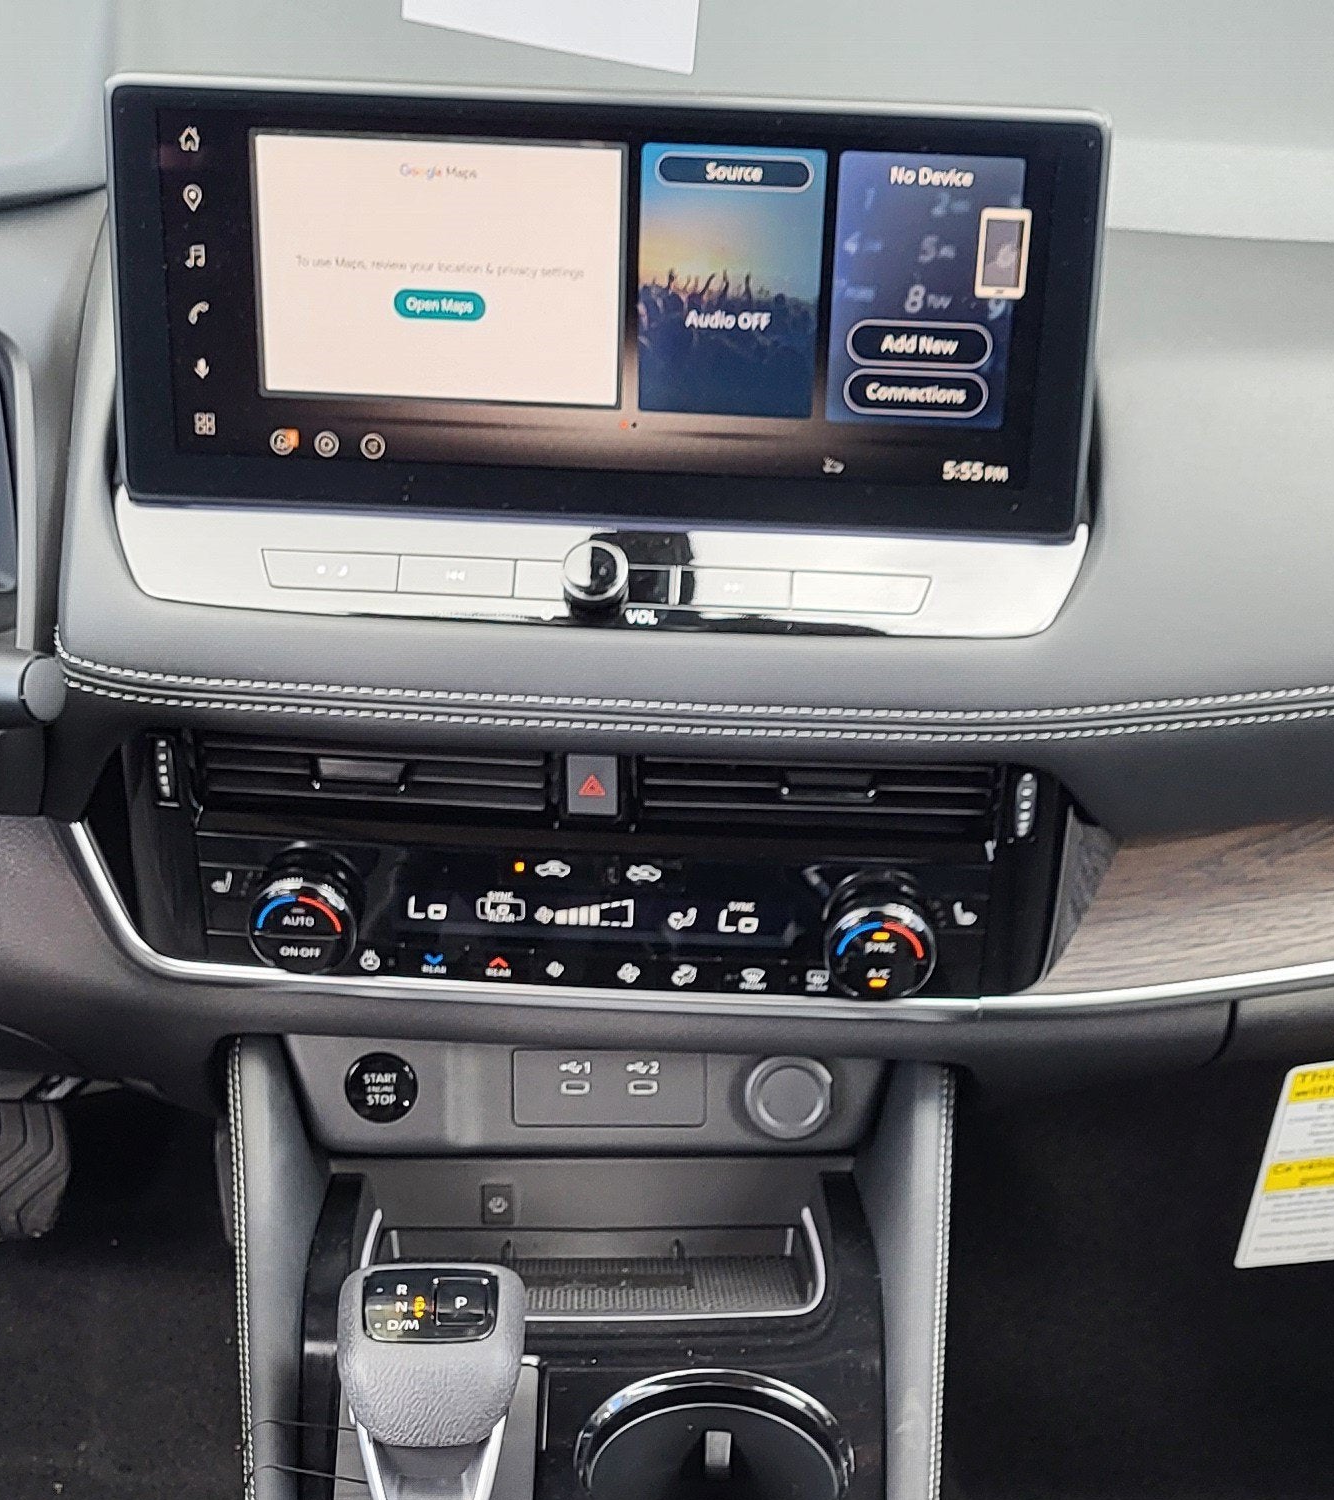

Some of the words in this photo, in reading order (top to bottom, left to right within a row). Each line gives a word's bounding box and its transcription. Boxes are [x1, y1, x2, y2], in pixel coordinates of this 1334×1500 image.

[400, 163, 441, 179] Google
[445, 165, 478, 179] Maps
[704, 162, 764, 183] Source
[890, 165, 916, 185] No
[918, 166, 975, 187] Device
[296, 255, 310, 267] To
[437, 261, 483, 273] location
[496, 265, 537, 279] privacy
[540, 266, 585, 281] settings
[405, 296, 439, 314] Open
[440, 297, 475, 316] Maps
[685, 311, 735, 331] Audio
[738, 311, 771, 332] OFF
[880, 334, 918, 355] Add
[919, 335, 959, 357] New
[865, 381, 967, 405] Connections
[942, 461, 984, 483] 5:55
[625, 610, 658, 625] VOL
[408, 895, 448, 920] Lo
[282, 915, 315, 927] AUTO
[583, 1061, 591, 1074] 1
[648, 1061, 660, 1075] 2
[362, 1072, 397, 1085] START
[366, 1094, 397, 1106] STOP
[396, 1284, 408, 1296] R
[394, 1301, 408, 1313] N
[454, 1296, 468, 1309] P
[386, 1319, 420, 1332] D/M
